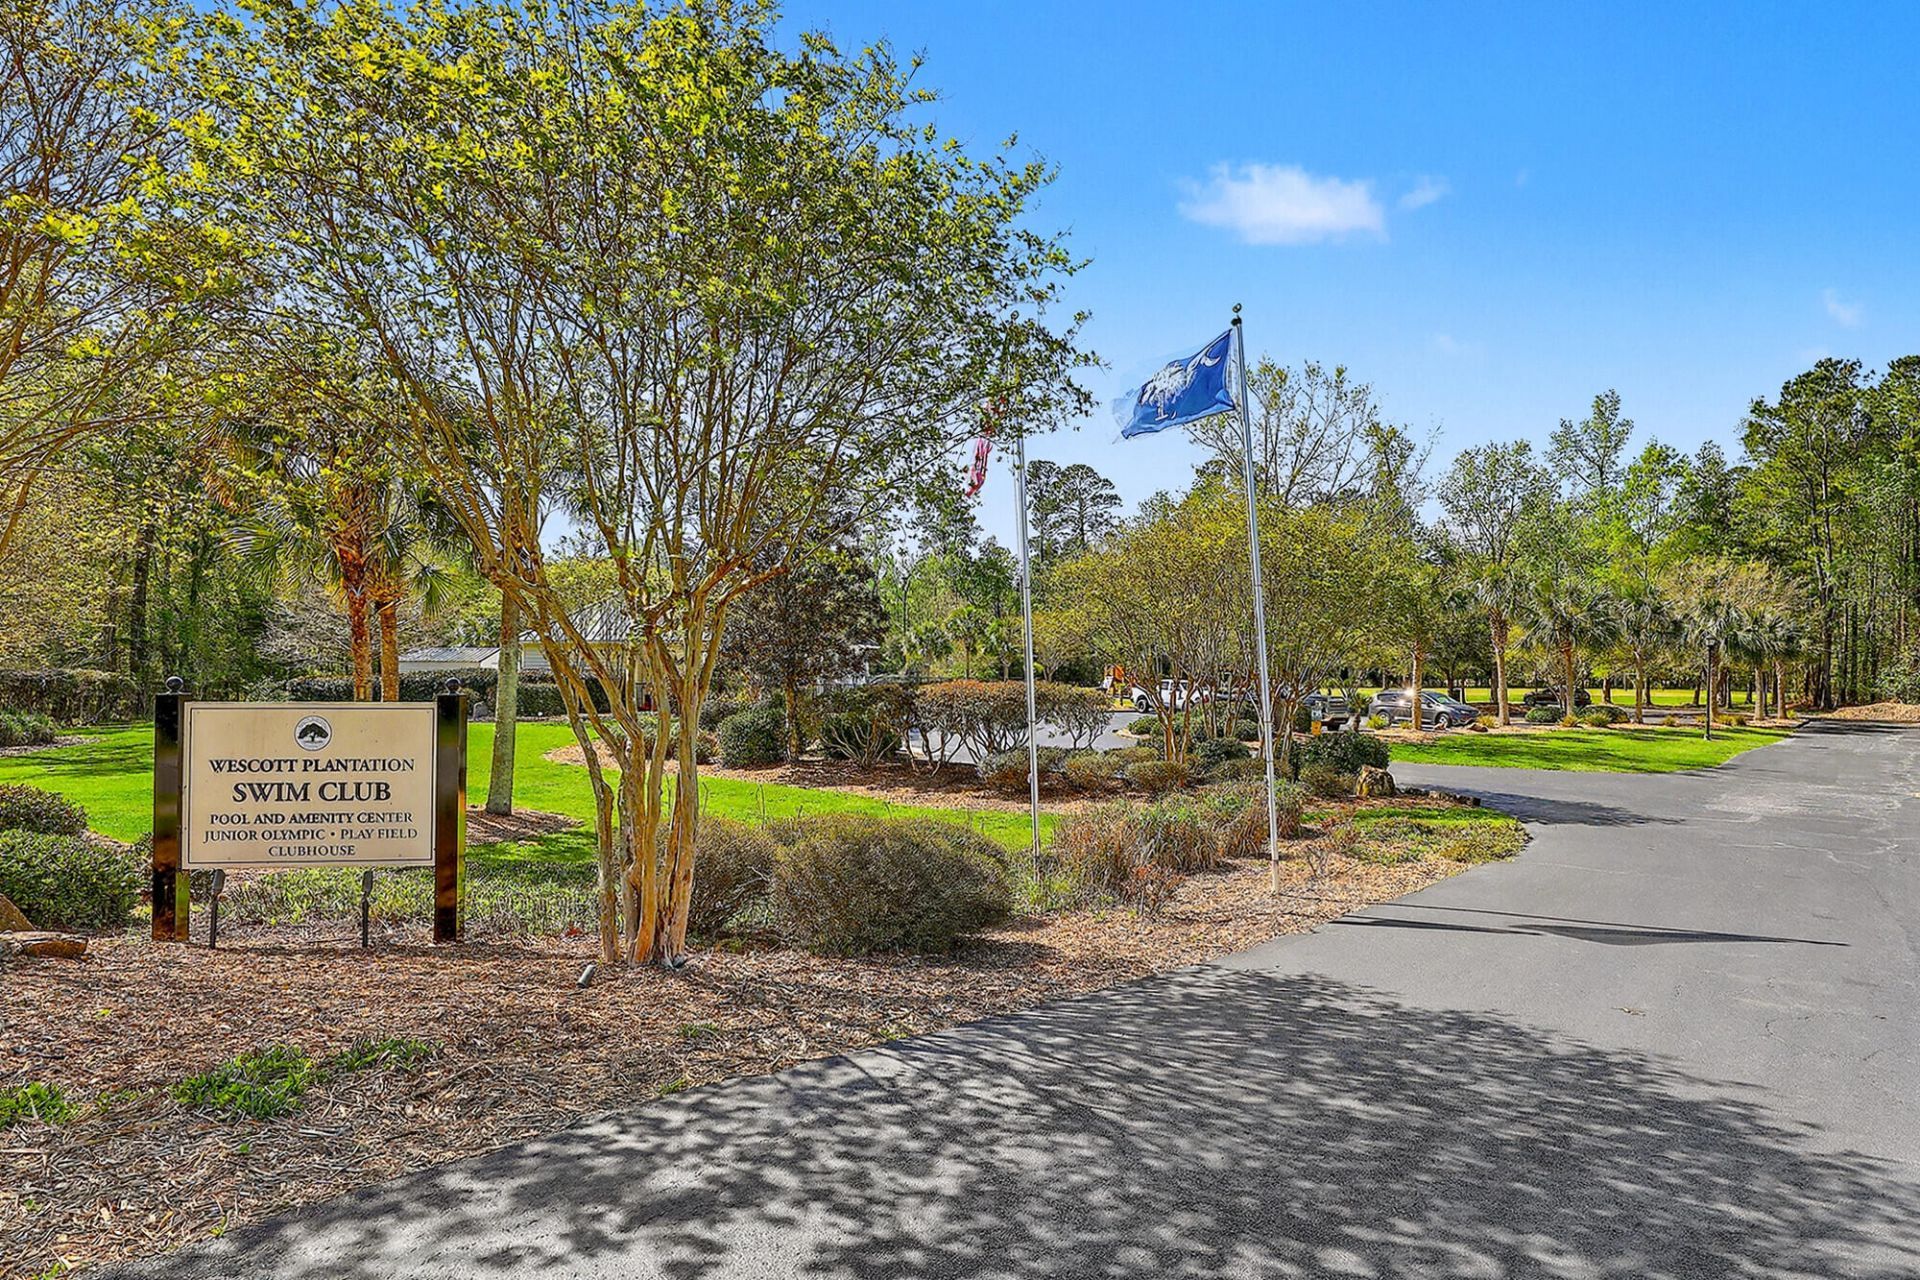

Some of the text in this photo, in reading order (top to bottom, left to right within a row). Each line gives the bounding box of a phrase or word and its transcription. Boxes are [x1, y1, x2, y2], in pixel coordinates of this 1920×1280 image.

[209, 758, 415, 773] WESCOTT PLANTATION
[232, 781, 391, 802] SWIM CLUB
[210, 812, 413, 825] POOL AND AMENITY CENTER
[203, 828, 418, 844] JUNIOR OLYMPIC PLAY FIELD
[268, 845, 356, 857] CLUBHOUSE
